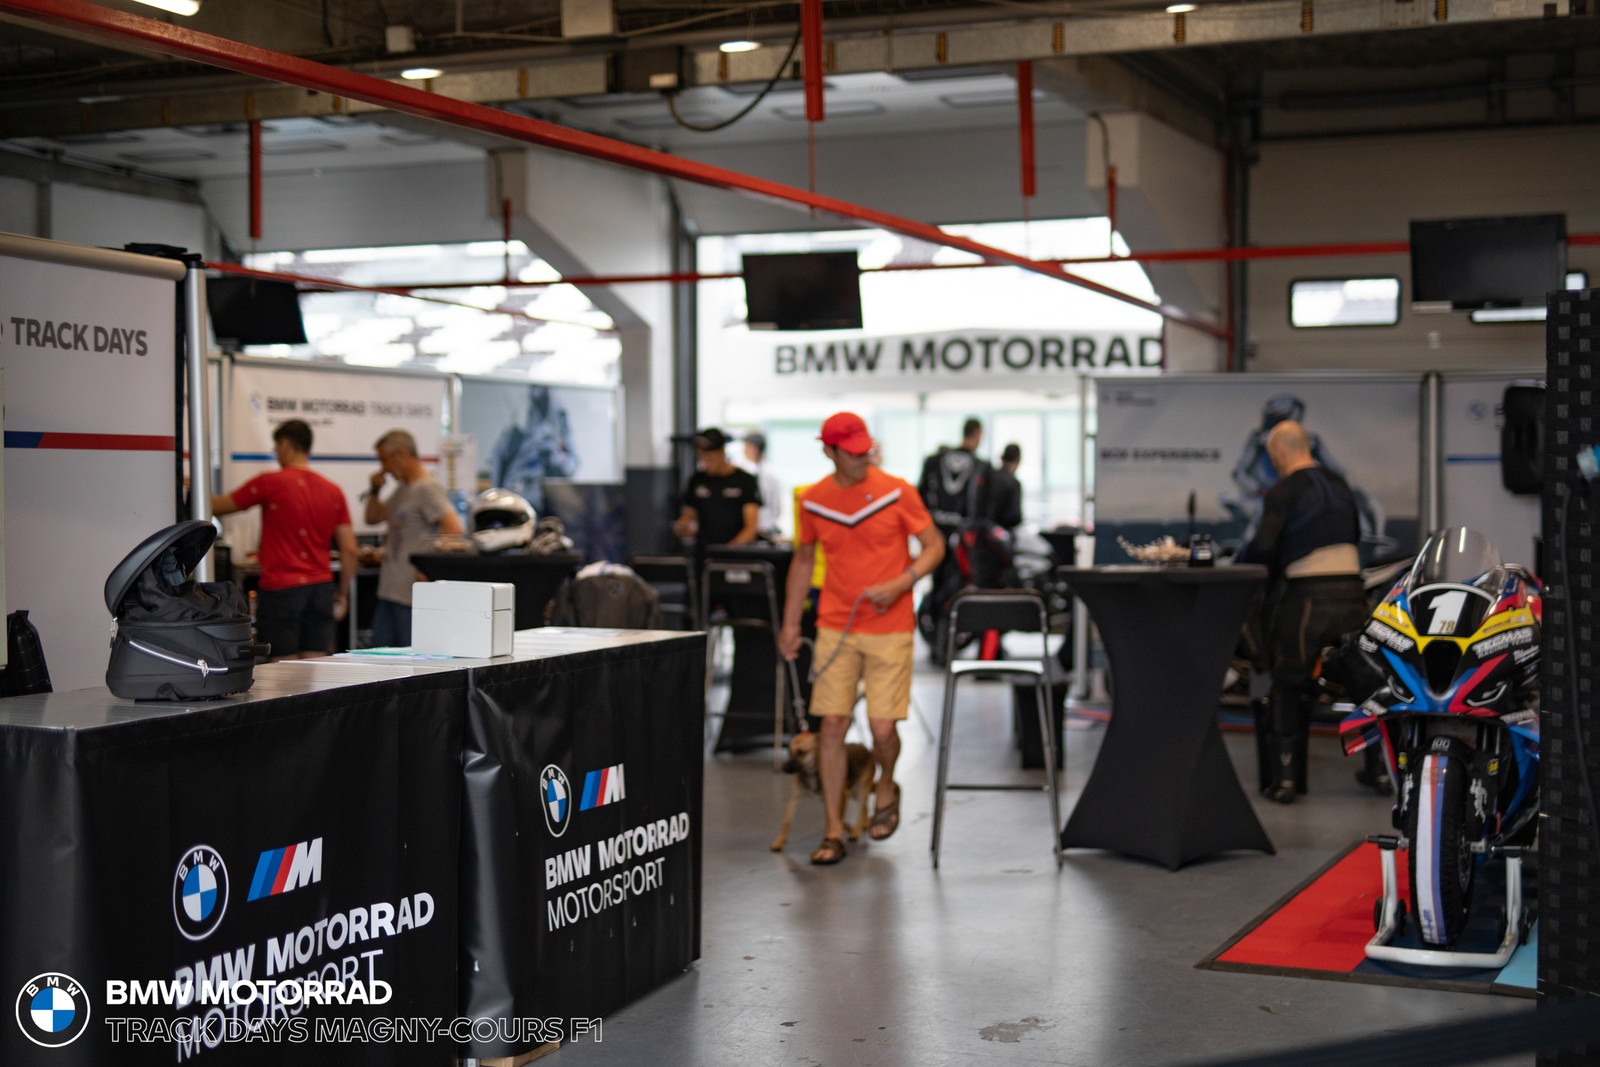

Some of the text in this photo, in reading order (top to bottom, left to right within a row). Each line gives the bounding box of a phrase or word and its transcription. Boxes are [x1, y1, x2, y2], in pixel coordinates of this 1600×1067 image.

[10, 316, 148, 356] TRACK DAYS
[774, 336, 1164, 375] BMW MOTORRAD
[1427, 591, 1467, 635] 1
[1438, 620, 1455, 633] 78
[1472, 627, 1533, 652] TECMAS
[545, 812, 690, 890] BMW MOTORRAD
[547, 856, 666, 932] MOTORSPORT
[175, 892, 435, 1011] BMW MOTORRAD
[177, 949, 384, 1063] MOTORSPORT
